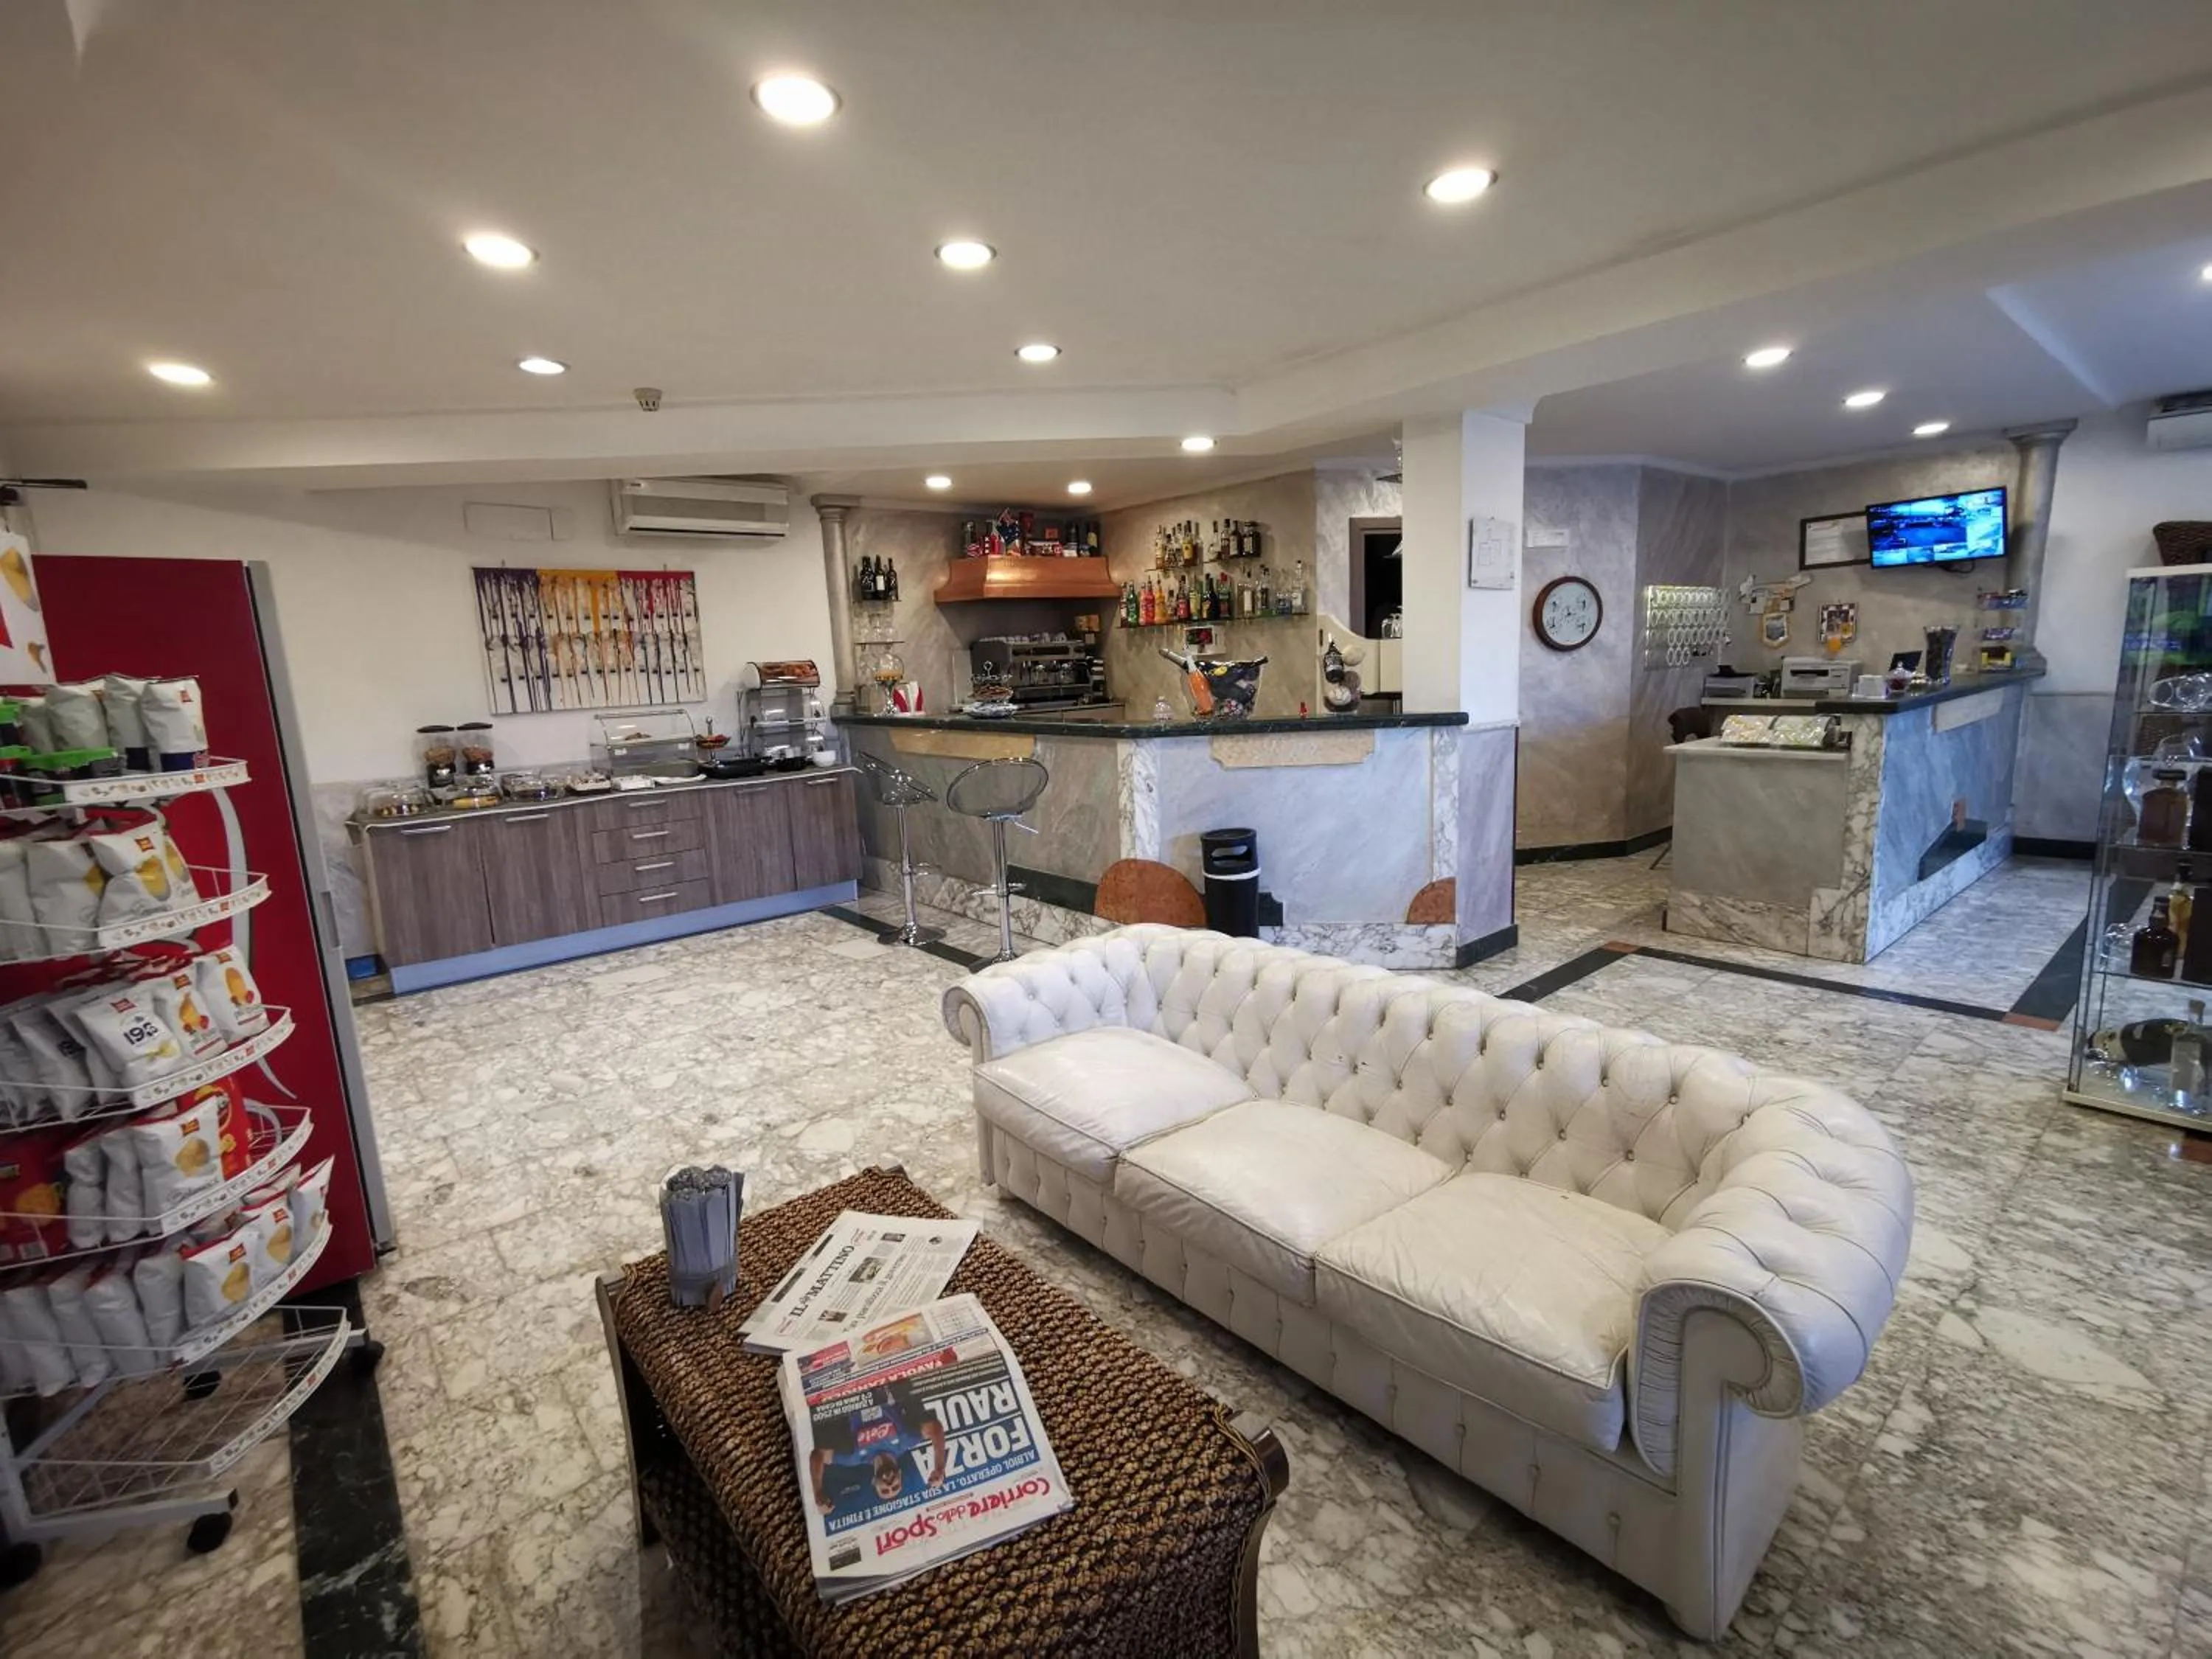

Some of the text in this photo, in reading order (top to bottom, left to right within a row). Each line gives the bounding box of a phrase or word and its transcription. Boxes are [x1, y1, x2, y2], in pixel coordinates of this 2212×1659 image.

[789, 1245, 855, 1317] IL MATTINO
[923, 1380, 1018, 1432] RAUL
[911, 1416, 1031, 1484] FORZA
[1003, 1449, 1035, 1470] ALBIOL
[872, 1492, 921, 1516] STAGIONE
[944, 1479, 956, 1492] LA
[967, 1477, 1051, 1518] Corriere
[828, 1511, 863, 1531] FINITA
[875, 1514, 937, 1556] Sport
